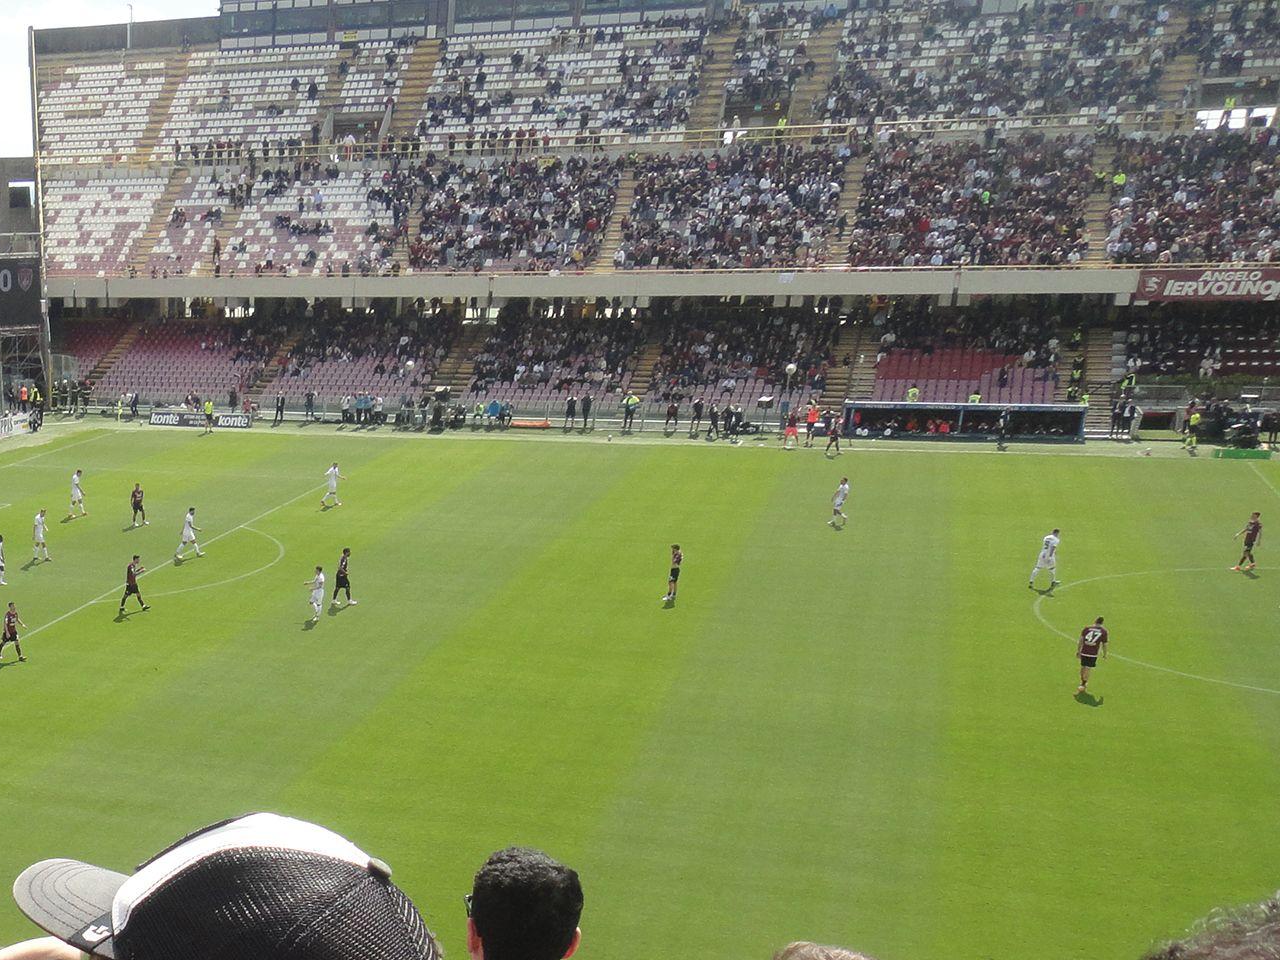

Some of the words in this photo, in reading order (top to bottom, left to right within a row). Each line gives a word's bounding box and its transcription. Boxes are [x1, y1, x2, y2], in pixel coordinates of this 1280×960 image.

[0, 269, 11, 292] 0
[1198, 271, 1262, 281] ANGELO
[218, 415, 248, 427] konte
[1085, 631, 1102, 643] 47
